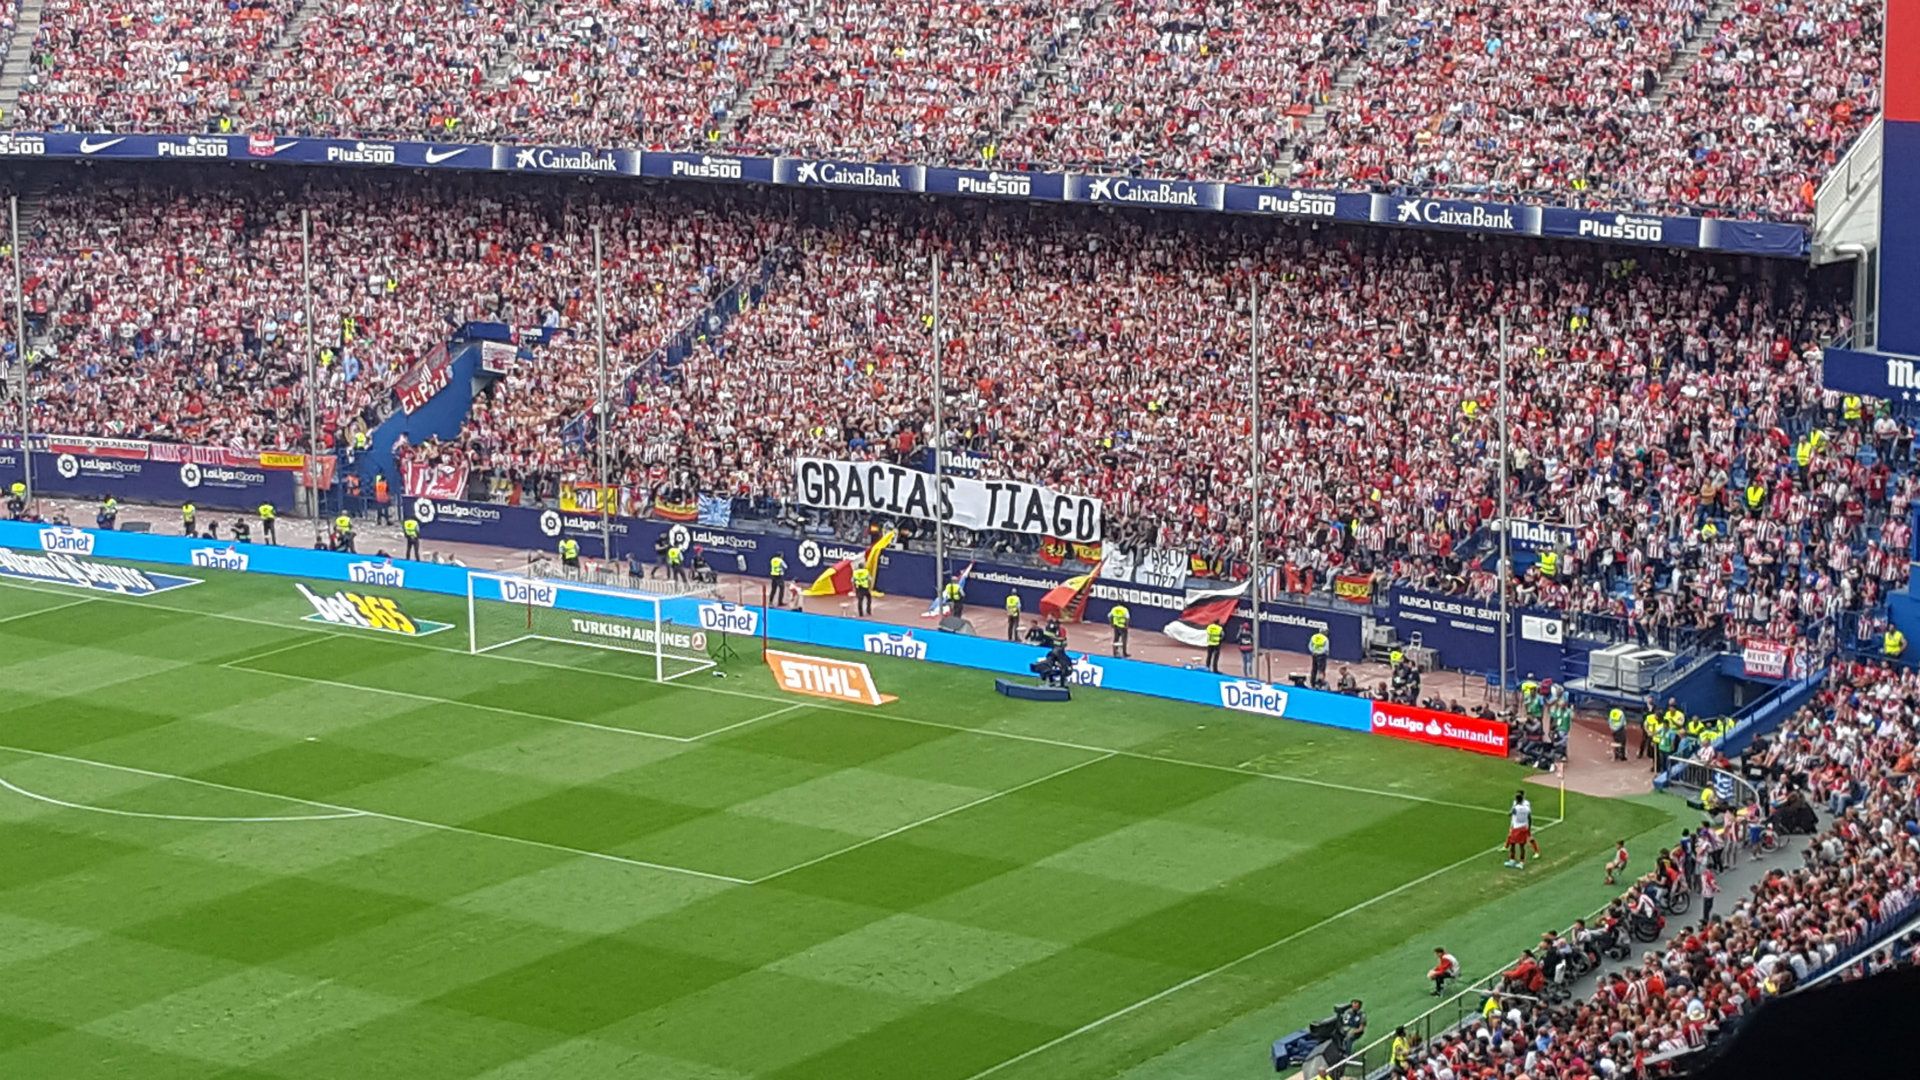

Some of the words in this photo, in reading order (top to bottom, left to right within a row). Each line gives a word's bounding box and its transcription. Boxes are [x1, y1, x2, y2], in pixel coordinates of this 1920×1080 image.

[158, 142, 228, 156] Plus500
[327, 147, 395, 163] Plus500
[539, 150, 617, 171] CaixaBank
[672, 160, 742, 178] Plus500
[820, 164, 901, 187] CaixaBank
[958, 177, 1030, 195] Plus500
[1114, 181, 1198, 205] CaixaBank
[1258, 195, 1336, 215] Plus500
[1423, 202, 1513, 229] CaixaBank
[1579, 219, 1662, 241] Plus500
[940, 450, 980, 470] Maho
[802, 461, 956, 521] GRACIAS
[986, 483, 1095, 540] TIAGO
[44, 532, 90, 552] Danet
[196, 552, 244, 570] Danet
[353, 566, 400, 587] Danet
[504, 580, 553, 602] Danet
[295, 583, 416, 634] bet365
[1398, 594, 1431, 609] NUNCA
[1433, 601, 1461, 614] DEJES
[1463, 606, 1476, 617] DE
[1477, 608, 1511, 623] SENTR
[571, 618, 631, 638] TURKISH
[703, 609, 753, 631] Danet
[869, 637, 921, 659] Danet
[780, 660, 861, 698] STIHL
[1224, 685, 1282, 712] Danet
[1388, 715, 1425, 732] LaLiga
[1443, 722, 1504, 746] Santander
